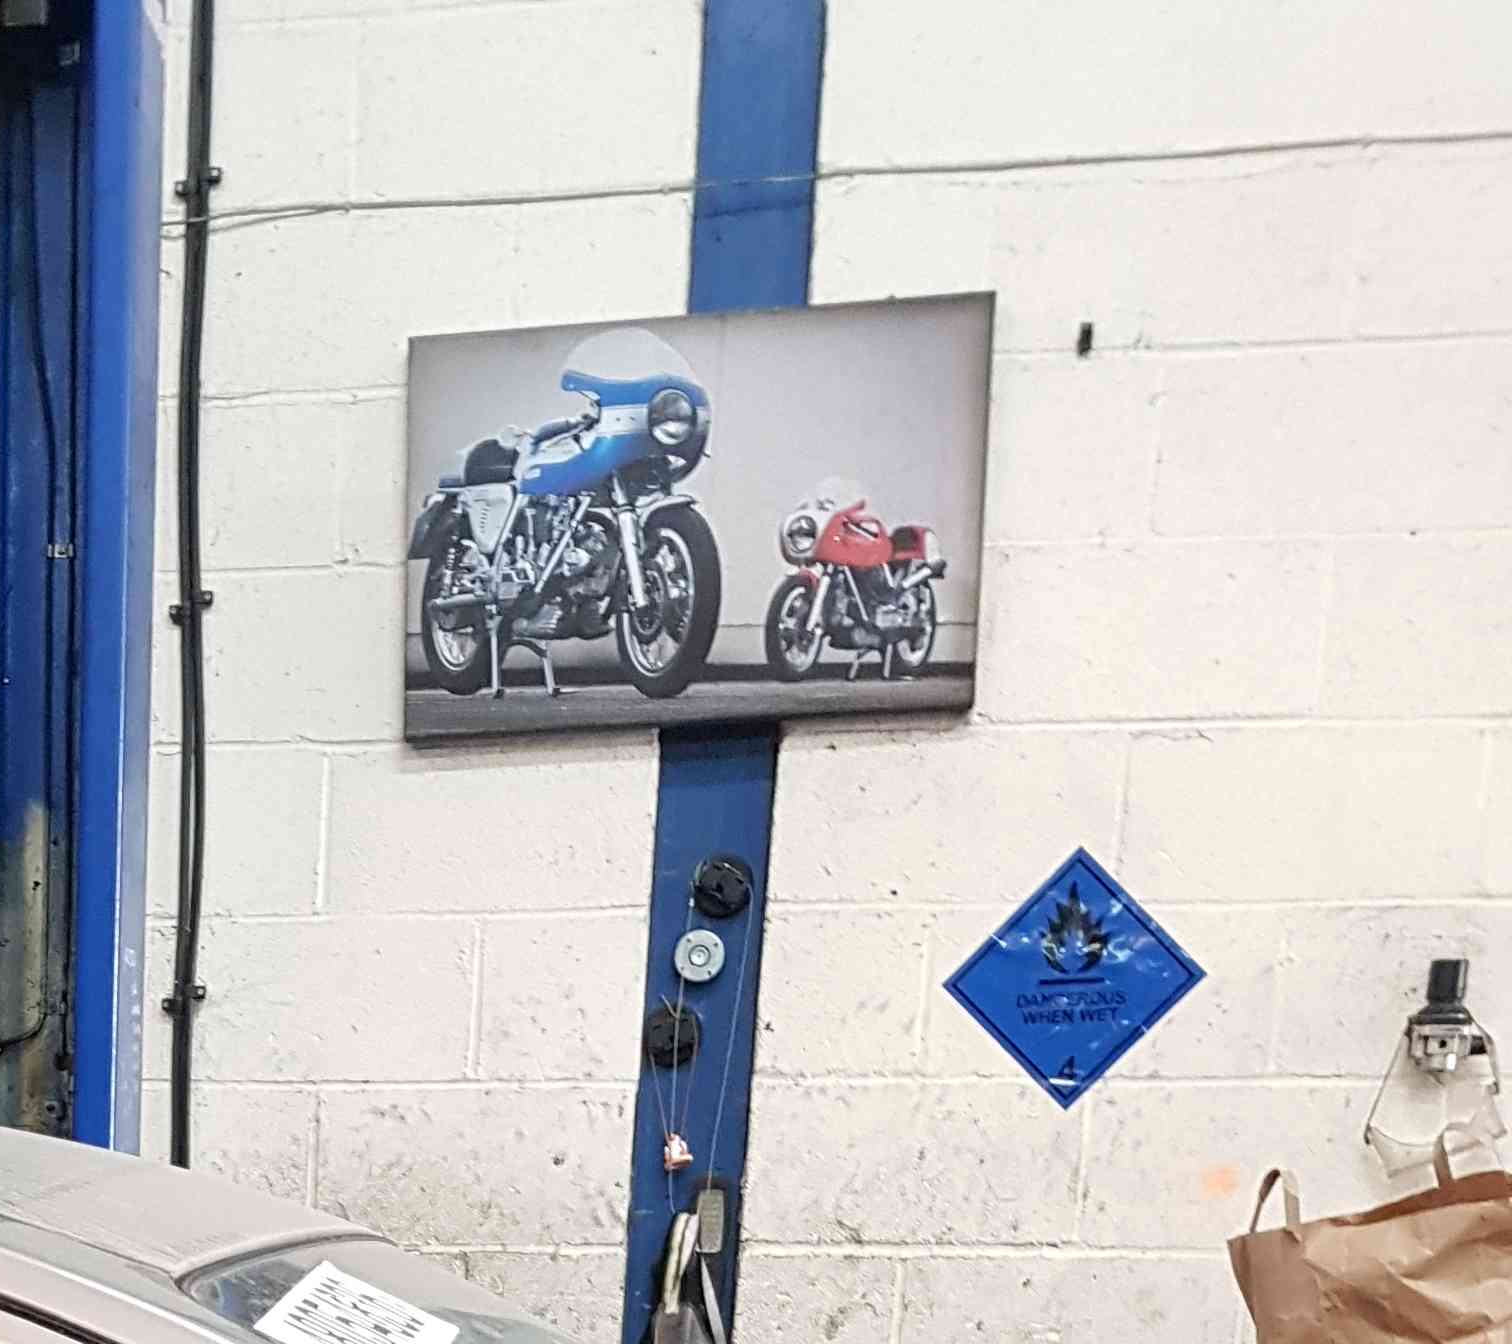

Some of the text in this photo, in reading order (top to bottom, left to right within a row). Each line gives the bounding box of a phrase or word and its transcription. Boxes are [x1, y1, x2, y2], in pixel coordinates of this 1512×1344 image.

[1022, 1007, 1120, 1025] WHEN WET
[1056, 1055, 1079, 1080] 4
